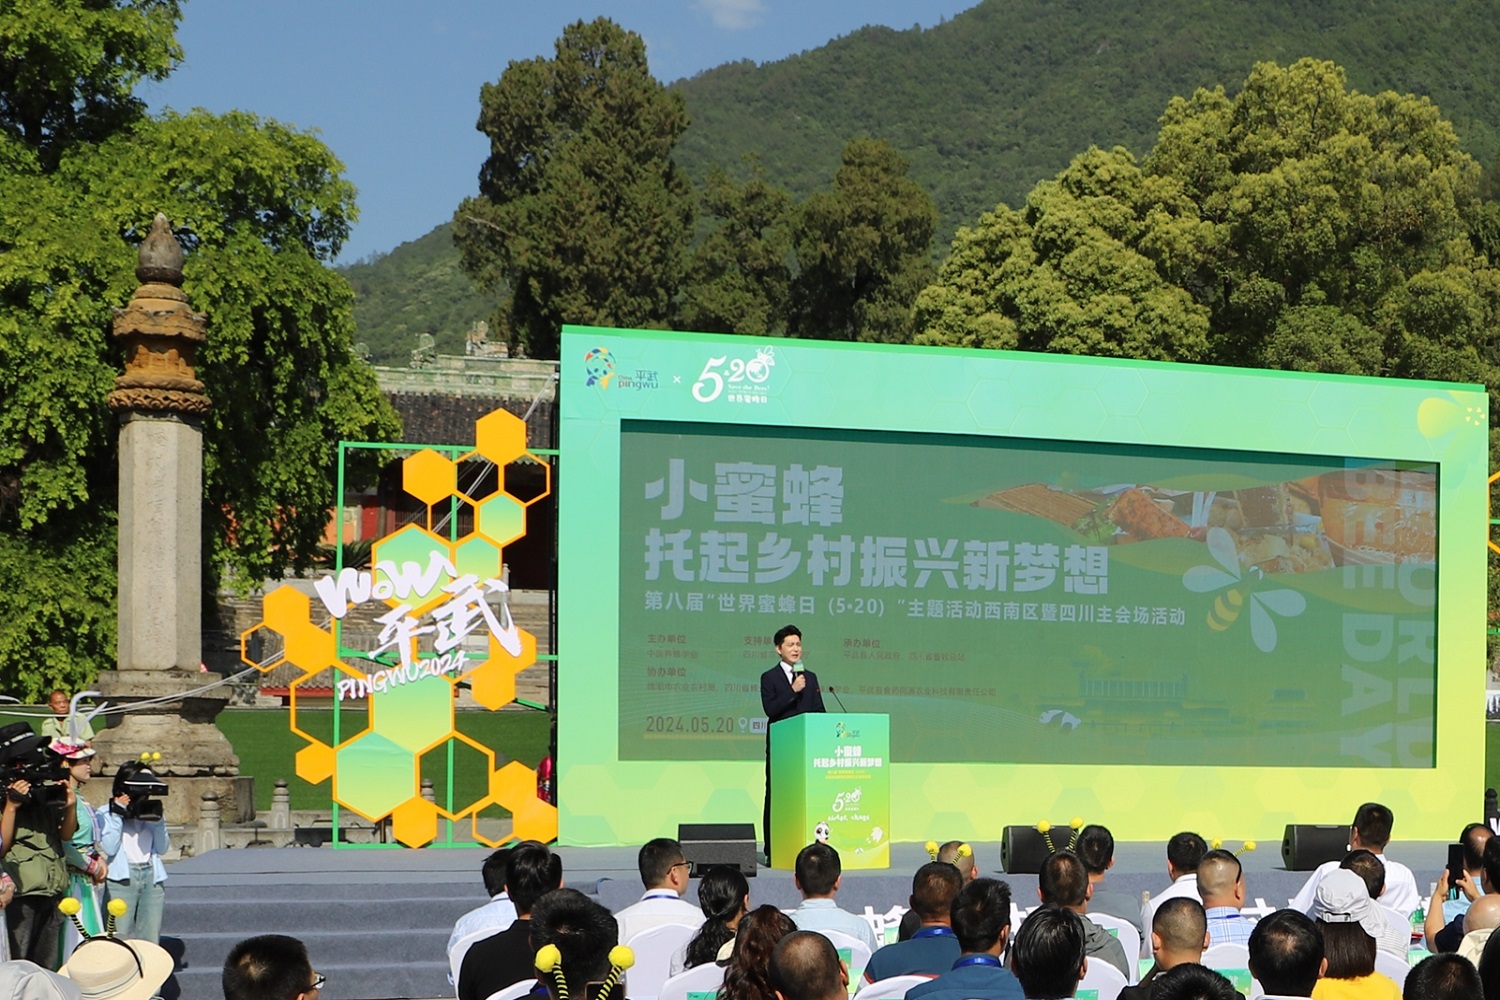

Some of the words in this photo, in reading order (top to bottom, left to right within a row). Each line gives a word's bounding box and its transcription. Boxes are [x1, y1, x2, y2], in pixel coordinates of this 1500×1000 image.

[635, 369, 659, 382] 平武
[618, 380, 659, 391] pingwu
[645, 458, 844, 527] 小蜜蜂
[645, 528, 1108, 595] 托起乡村振兴新梦想
[368, 573, 522, 676] 平武
[647, 634, 687, 645] 主办单位
[743, 635, 775, 646] 支持单
[843, 638, 881, 649] 承办单位
[336, 649, 470, 701] PINGWU2024
[647, 667, 687, 678] 协办单位
[646, 715, 734, 733] 2024.05.20
[834, 745, 862, 757] 小蜜蜂
[813, 757, 883, 768] 托起乡村振兴新梦想
